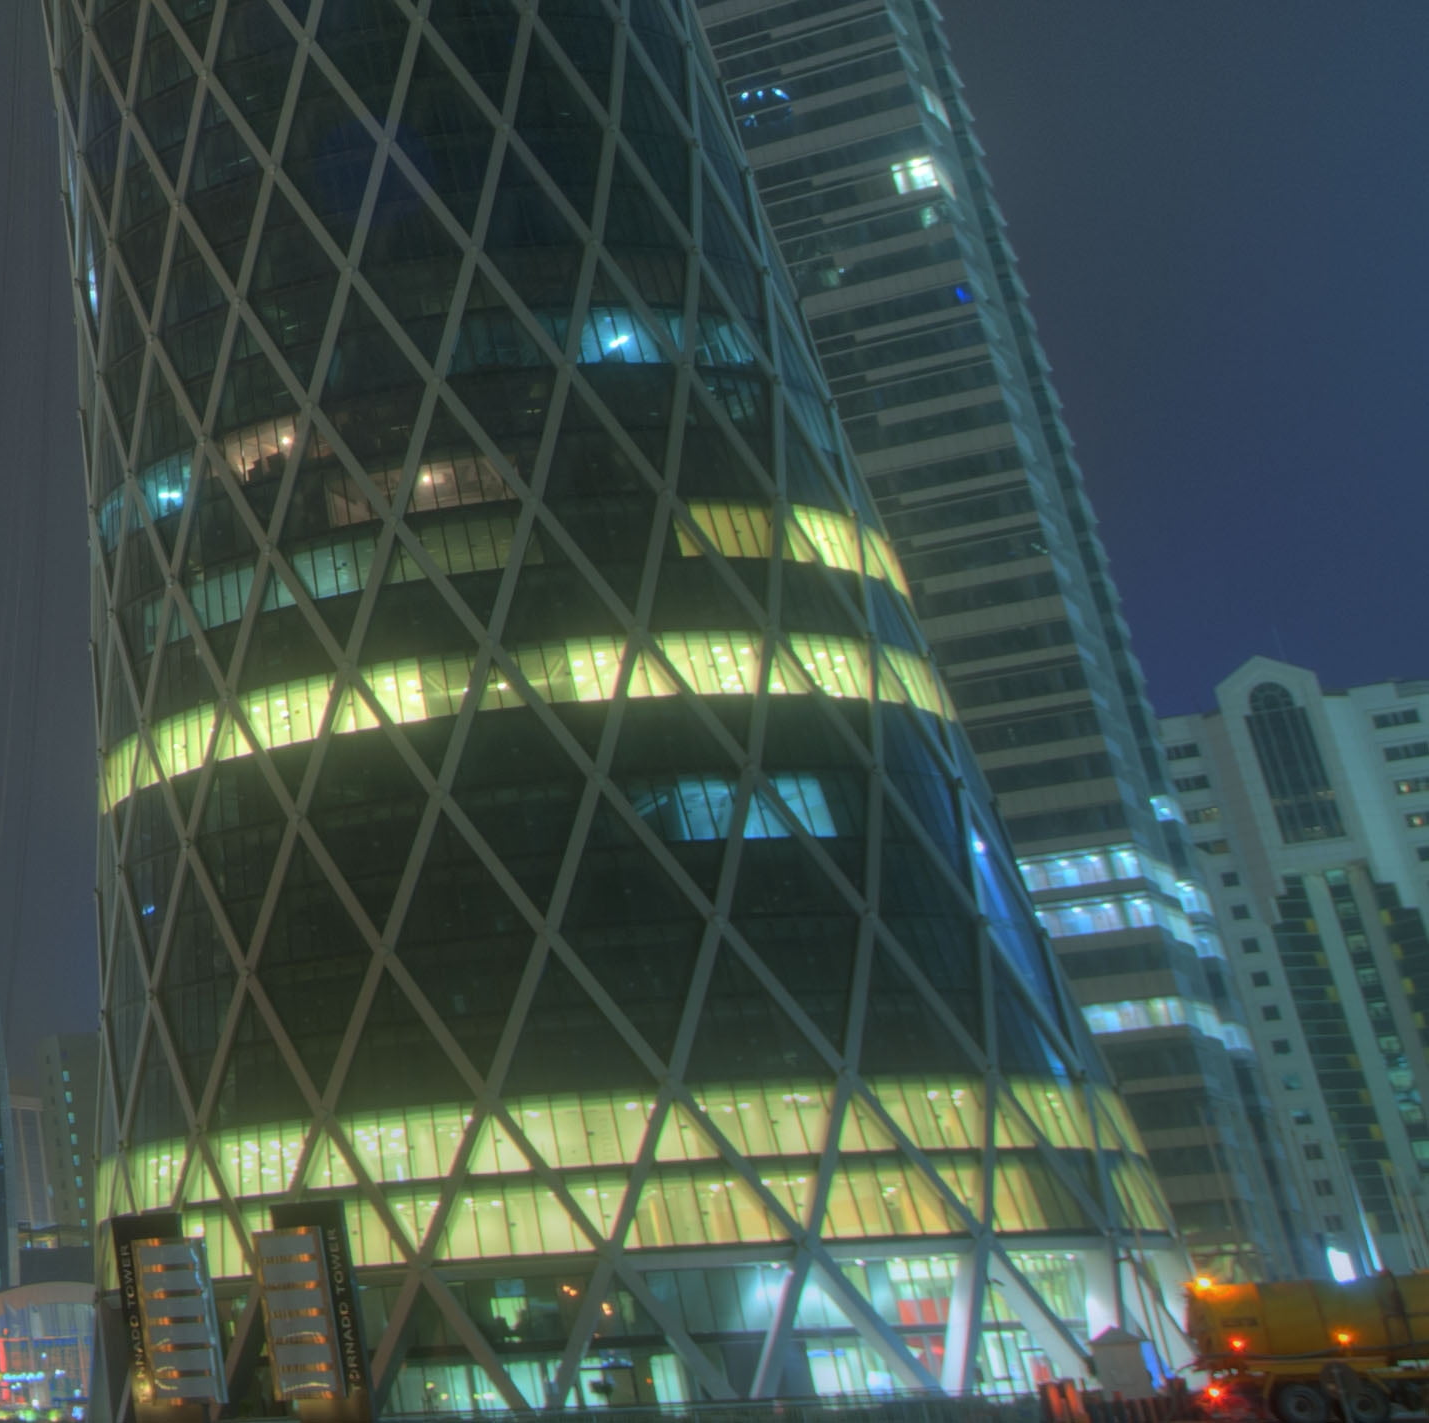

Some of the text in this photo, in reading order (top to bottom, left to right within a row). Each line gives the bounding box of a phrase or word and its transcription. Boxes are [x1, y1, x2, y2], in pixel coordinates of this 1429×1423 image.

[120, 1244, 137, 1309] TOWER
[327, 1228, 362, 1393] TORNADO TOWER
